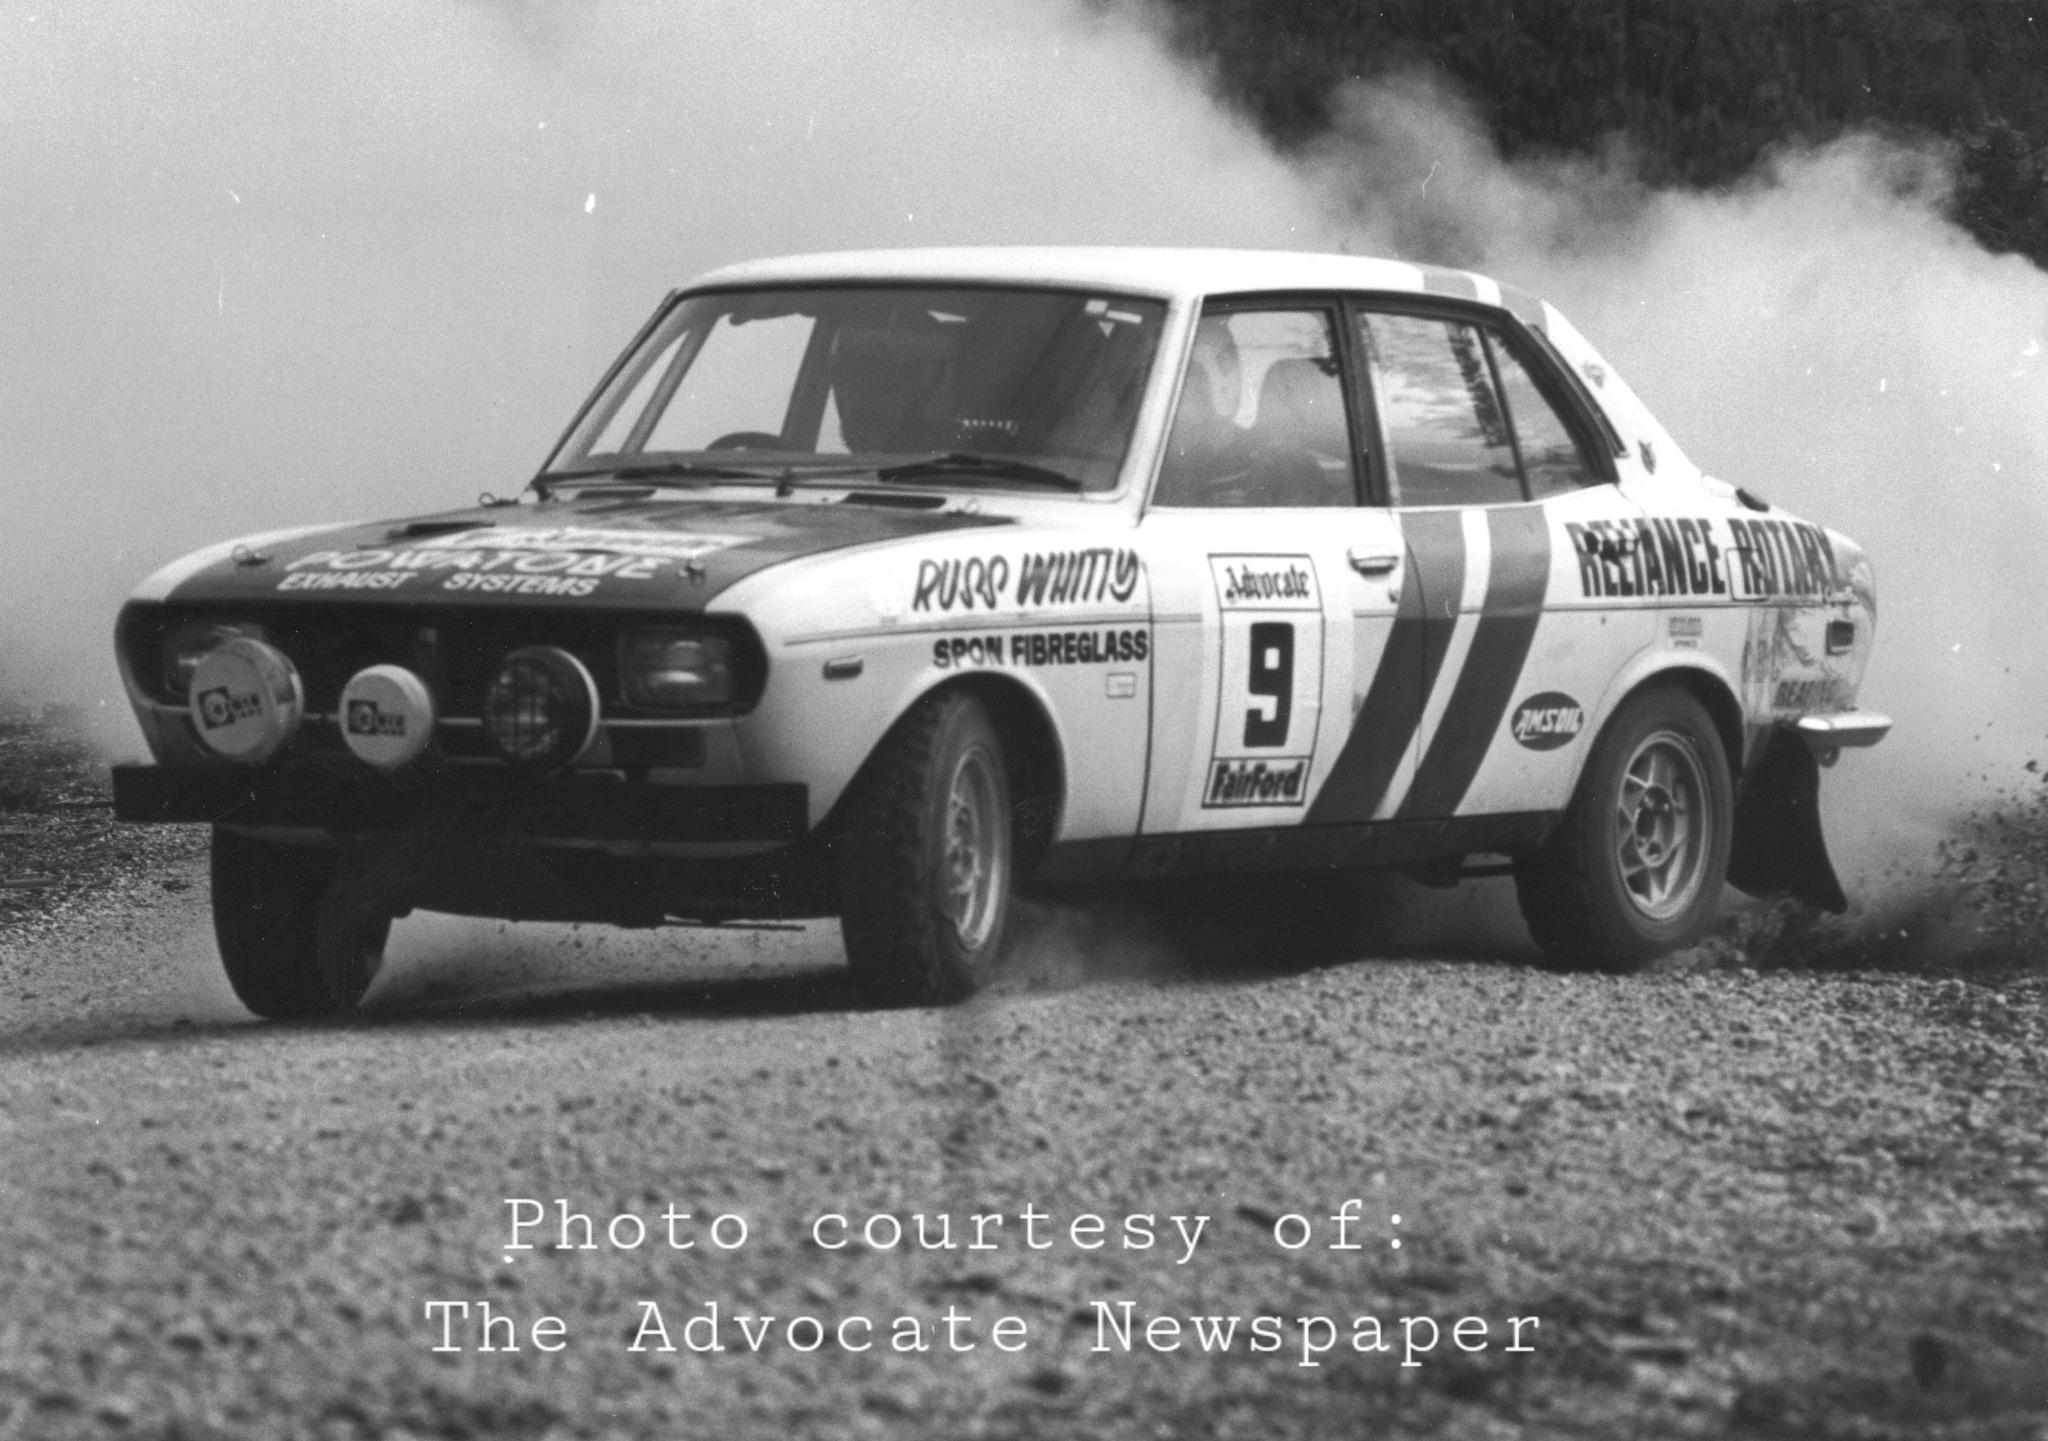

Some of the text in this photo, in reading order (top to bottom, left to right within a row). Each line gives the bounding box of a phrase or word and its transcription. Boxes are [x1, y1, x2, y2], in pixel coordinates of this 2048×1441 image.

[277, 571, 601, 597] EXHAUST SYSTEMS
[912, 547, 1139, 612] RUSS WHITTY
[1564, 517, 1840, 598] RELIANCE ROTARY
[933, 629, 1149, 668] SPON FIBREGLASS
[1243, 621, 1295, 749] 9
